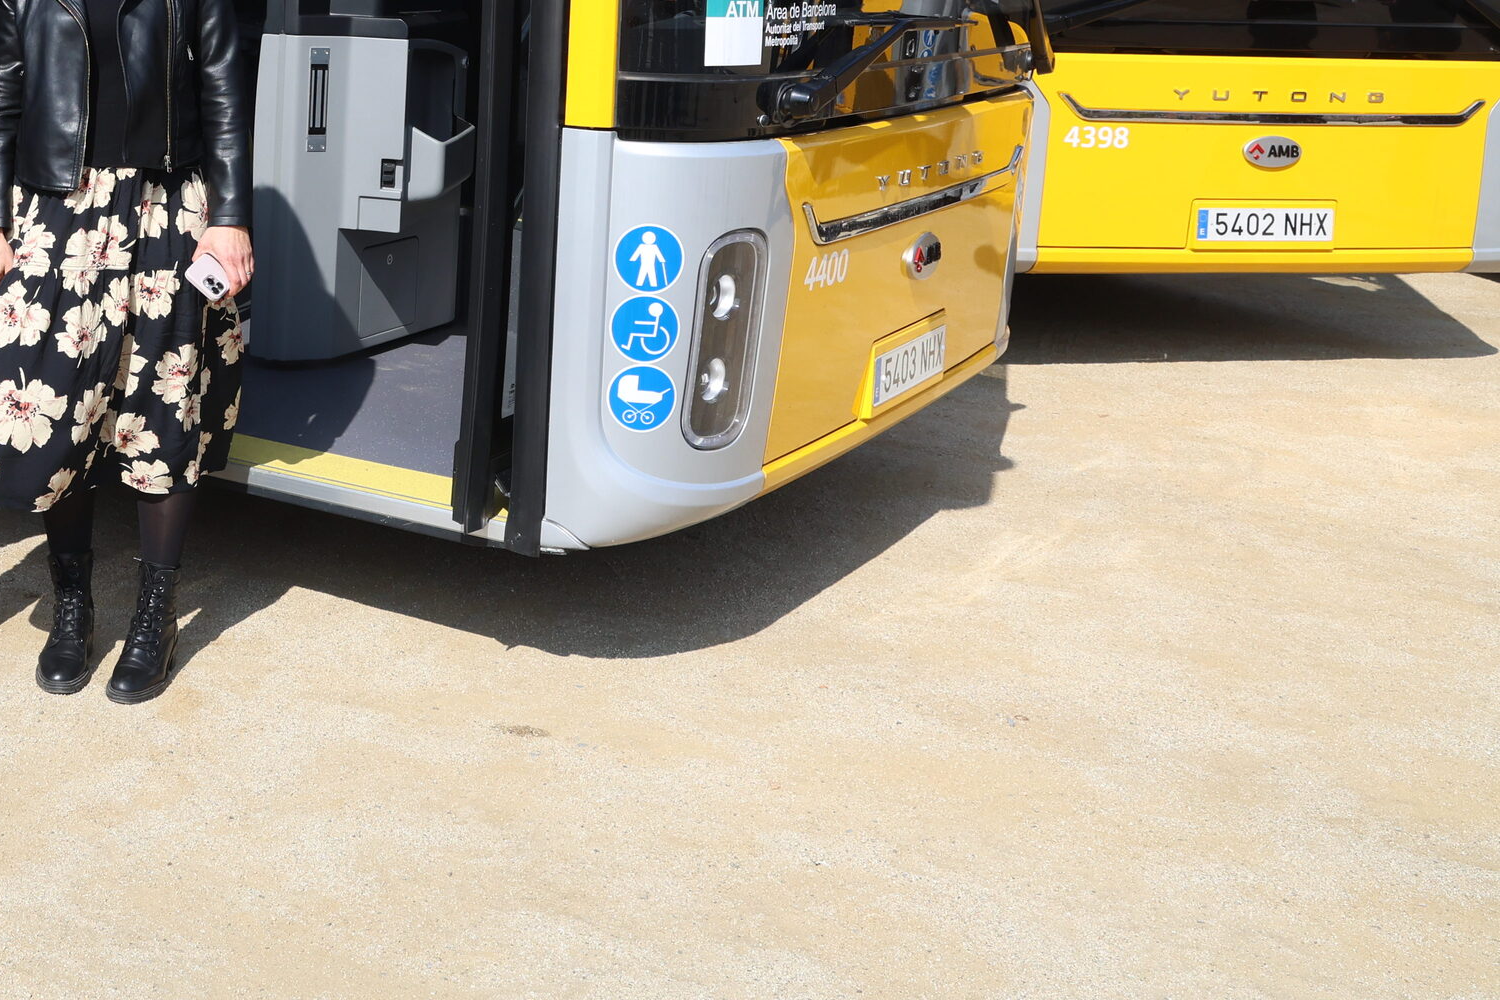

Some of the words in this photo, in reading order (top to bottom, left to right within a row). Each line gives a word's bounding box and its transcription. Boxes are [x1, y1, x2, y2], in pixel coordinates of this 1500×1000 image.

[726, 0, 759, 18] ATM
[766, 0, 788, 20] Àrea
[790, 2, 800, 19] de
[802, 1, 836, 18] Barcelona
[765, 22, 792, 35] Autoritat
[793, 21, 801, 32] del
[802, 21, 825, 33] Transport
[765, 35, 798, 48] Metropolità
[1174, 89, 1384, 103] YUTONG
[1063, 126, 1129, 149] 4398
[1267, 145, 1299, 158] AMB
[1215, 213, 1275, 236] 5402
[1284, 213, 1328, 236] NHX
[804, 248, 849, 292] 4400
[884, 346, 917, 393] 5403
[920, 332, 944, 375] NHX
